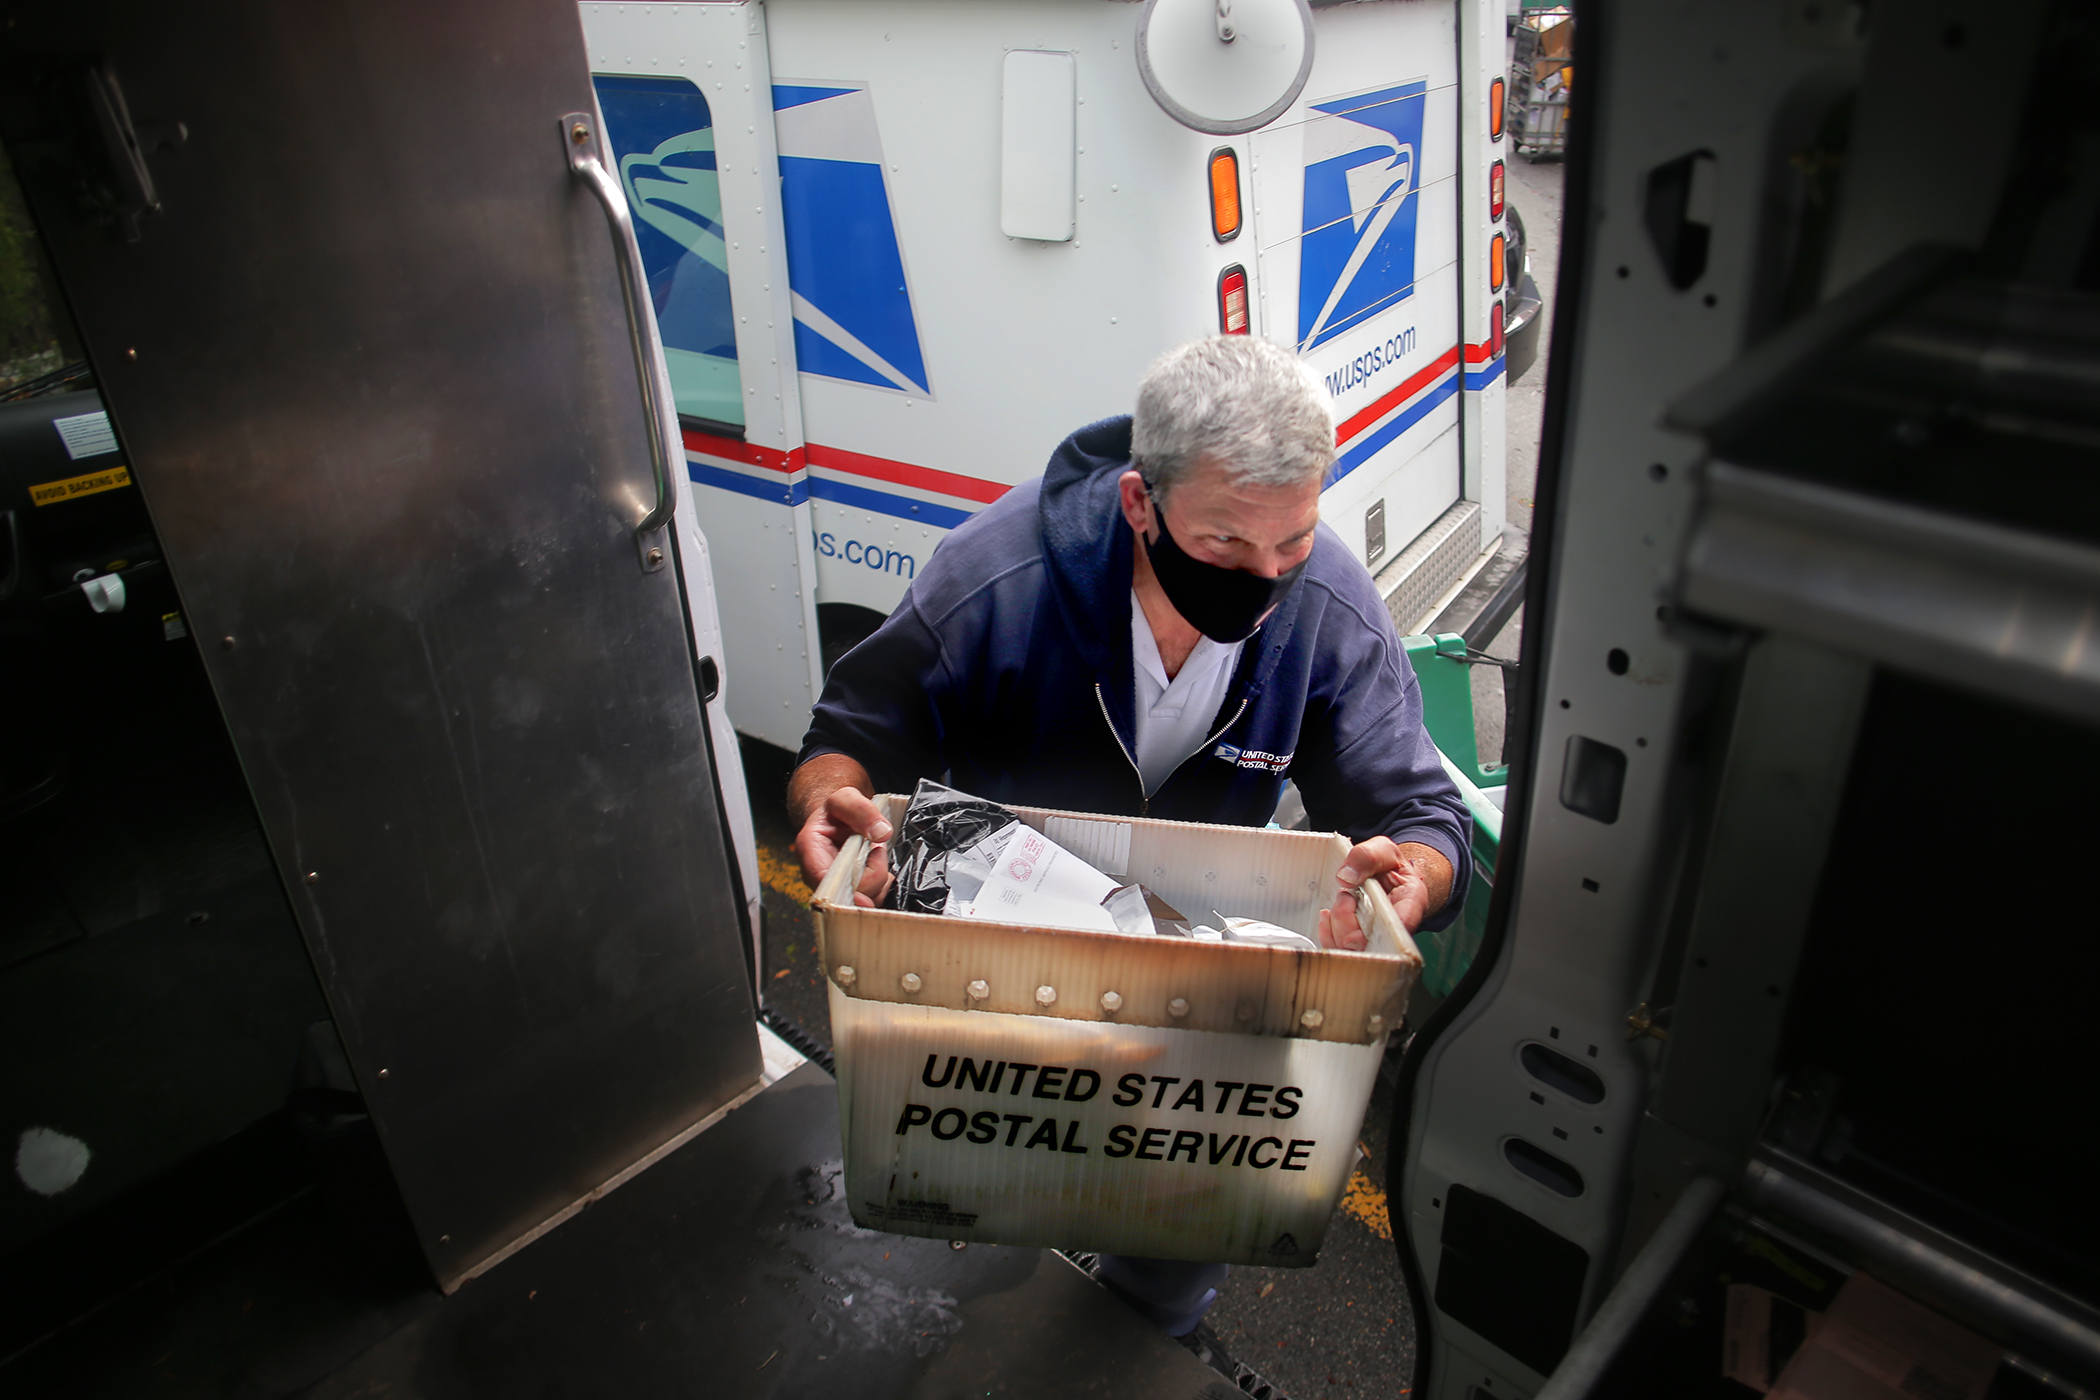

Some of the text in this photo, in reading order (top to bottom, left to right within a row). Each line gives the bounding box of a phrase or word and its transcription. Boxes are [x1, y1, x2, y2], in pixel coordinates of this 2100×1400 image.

[1325, 326, 1416, 398] w.usps.com
[35, 471, 129, 501] AVOID BACKING UP
[1236, 760, 1268, 770] POSTAL
[1241, 750, 1275, 761] UNITED
[921, 1054, 1304, 1119] UNITED STATES
[896, 1103, 1315, 1171] POSTAL SERVICE
